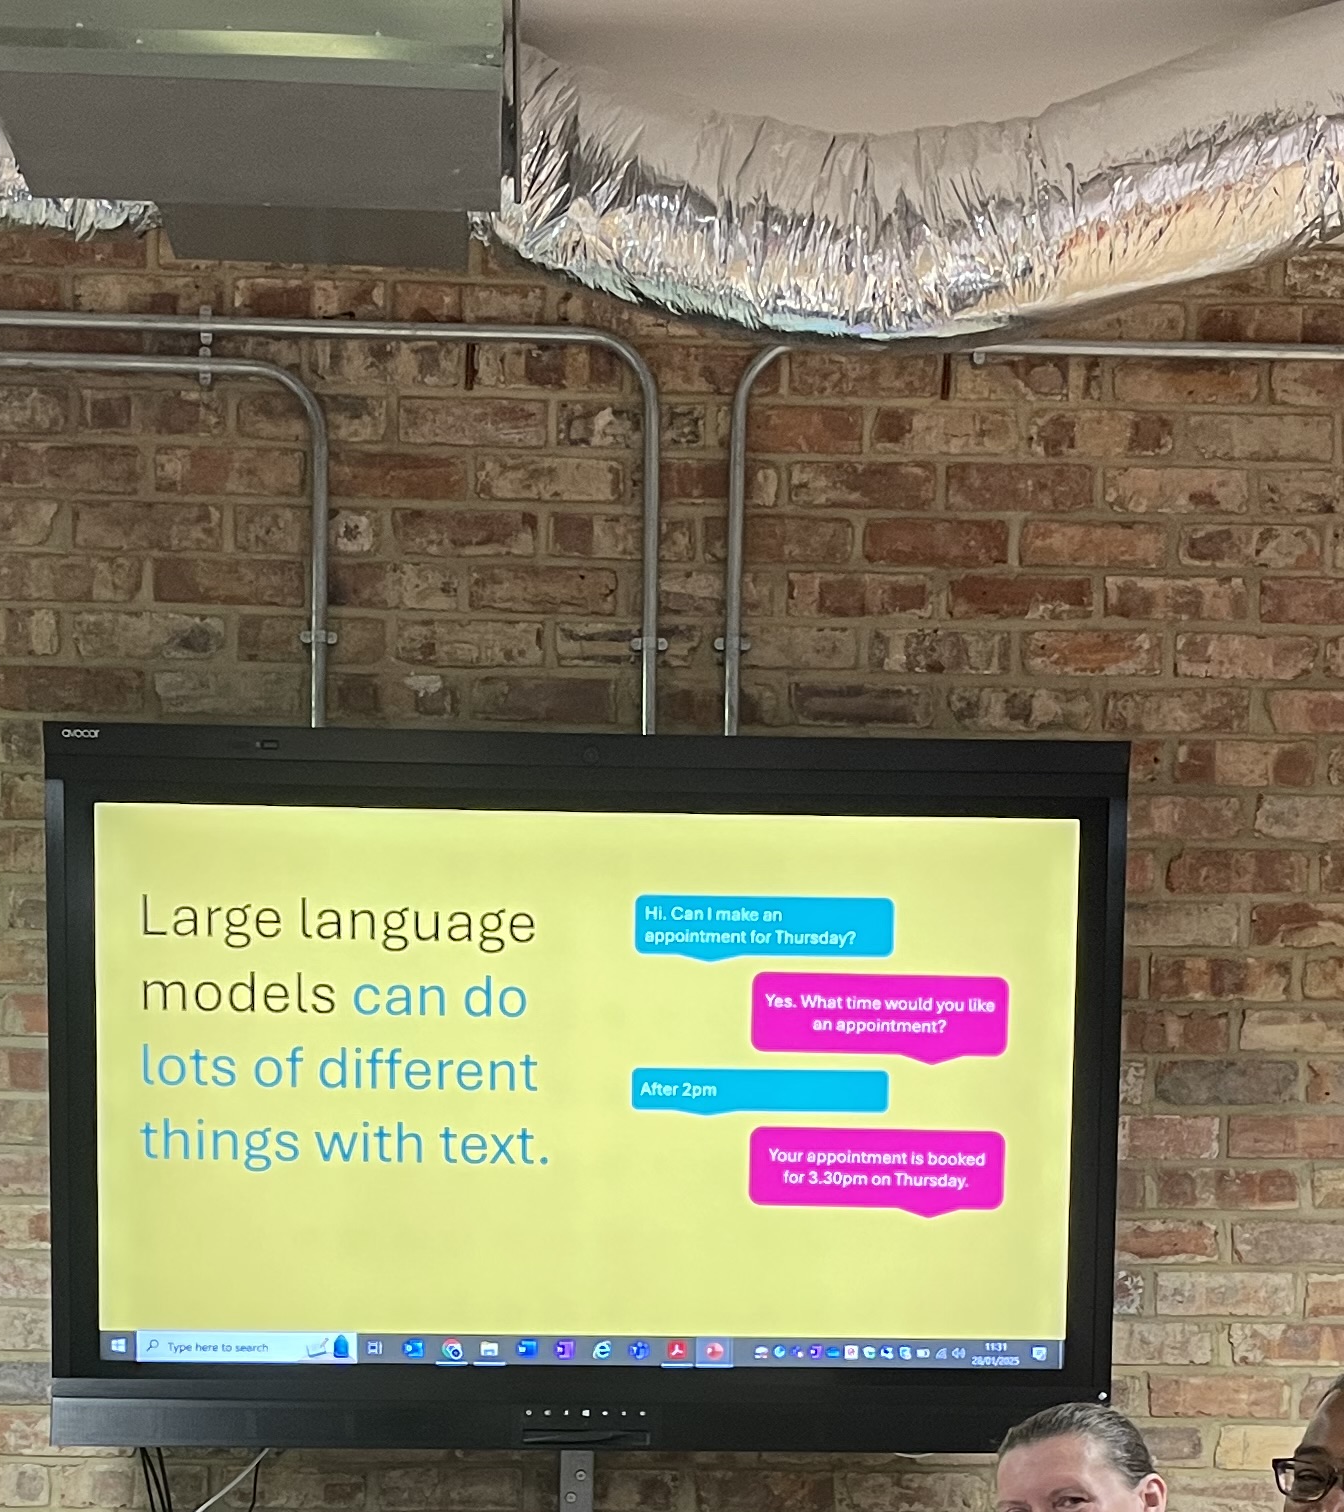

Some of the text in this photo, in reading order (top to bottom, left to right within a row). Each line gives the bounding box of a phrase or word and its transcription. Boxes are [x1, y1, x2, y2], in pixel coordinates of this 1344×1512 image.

[142, 894, 536, 953] Large language
[644, 906, 782, 922] Hi. Can I make an
[644, 929, 856, 948] appointment for Thursday?
[142, 971, 527, 1017] models can do
[764, 993, 996, 1016] Yes. What time would you like
[812, 1018, 947, 1034] an appointment?
[142, 1043, 538, 1091] lots of different
[640, 1082, 718, 1099] After 2pm
[139, 1117, 549, 1171] things with text.
[768, 1148, 986, 1167] Your appointment is booked
[783, 1170, 969, 1190] for 3.30pm on Thursday.
[168, 1342, 269, 1353] Type here to search
